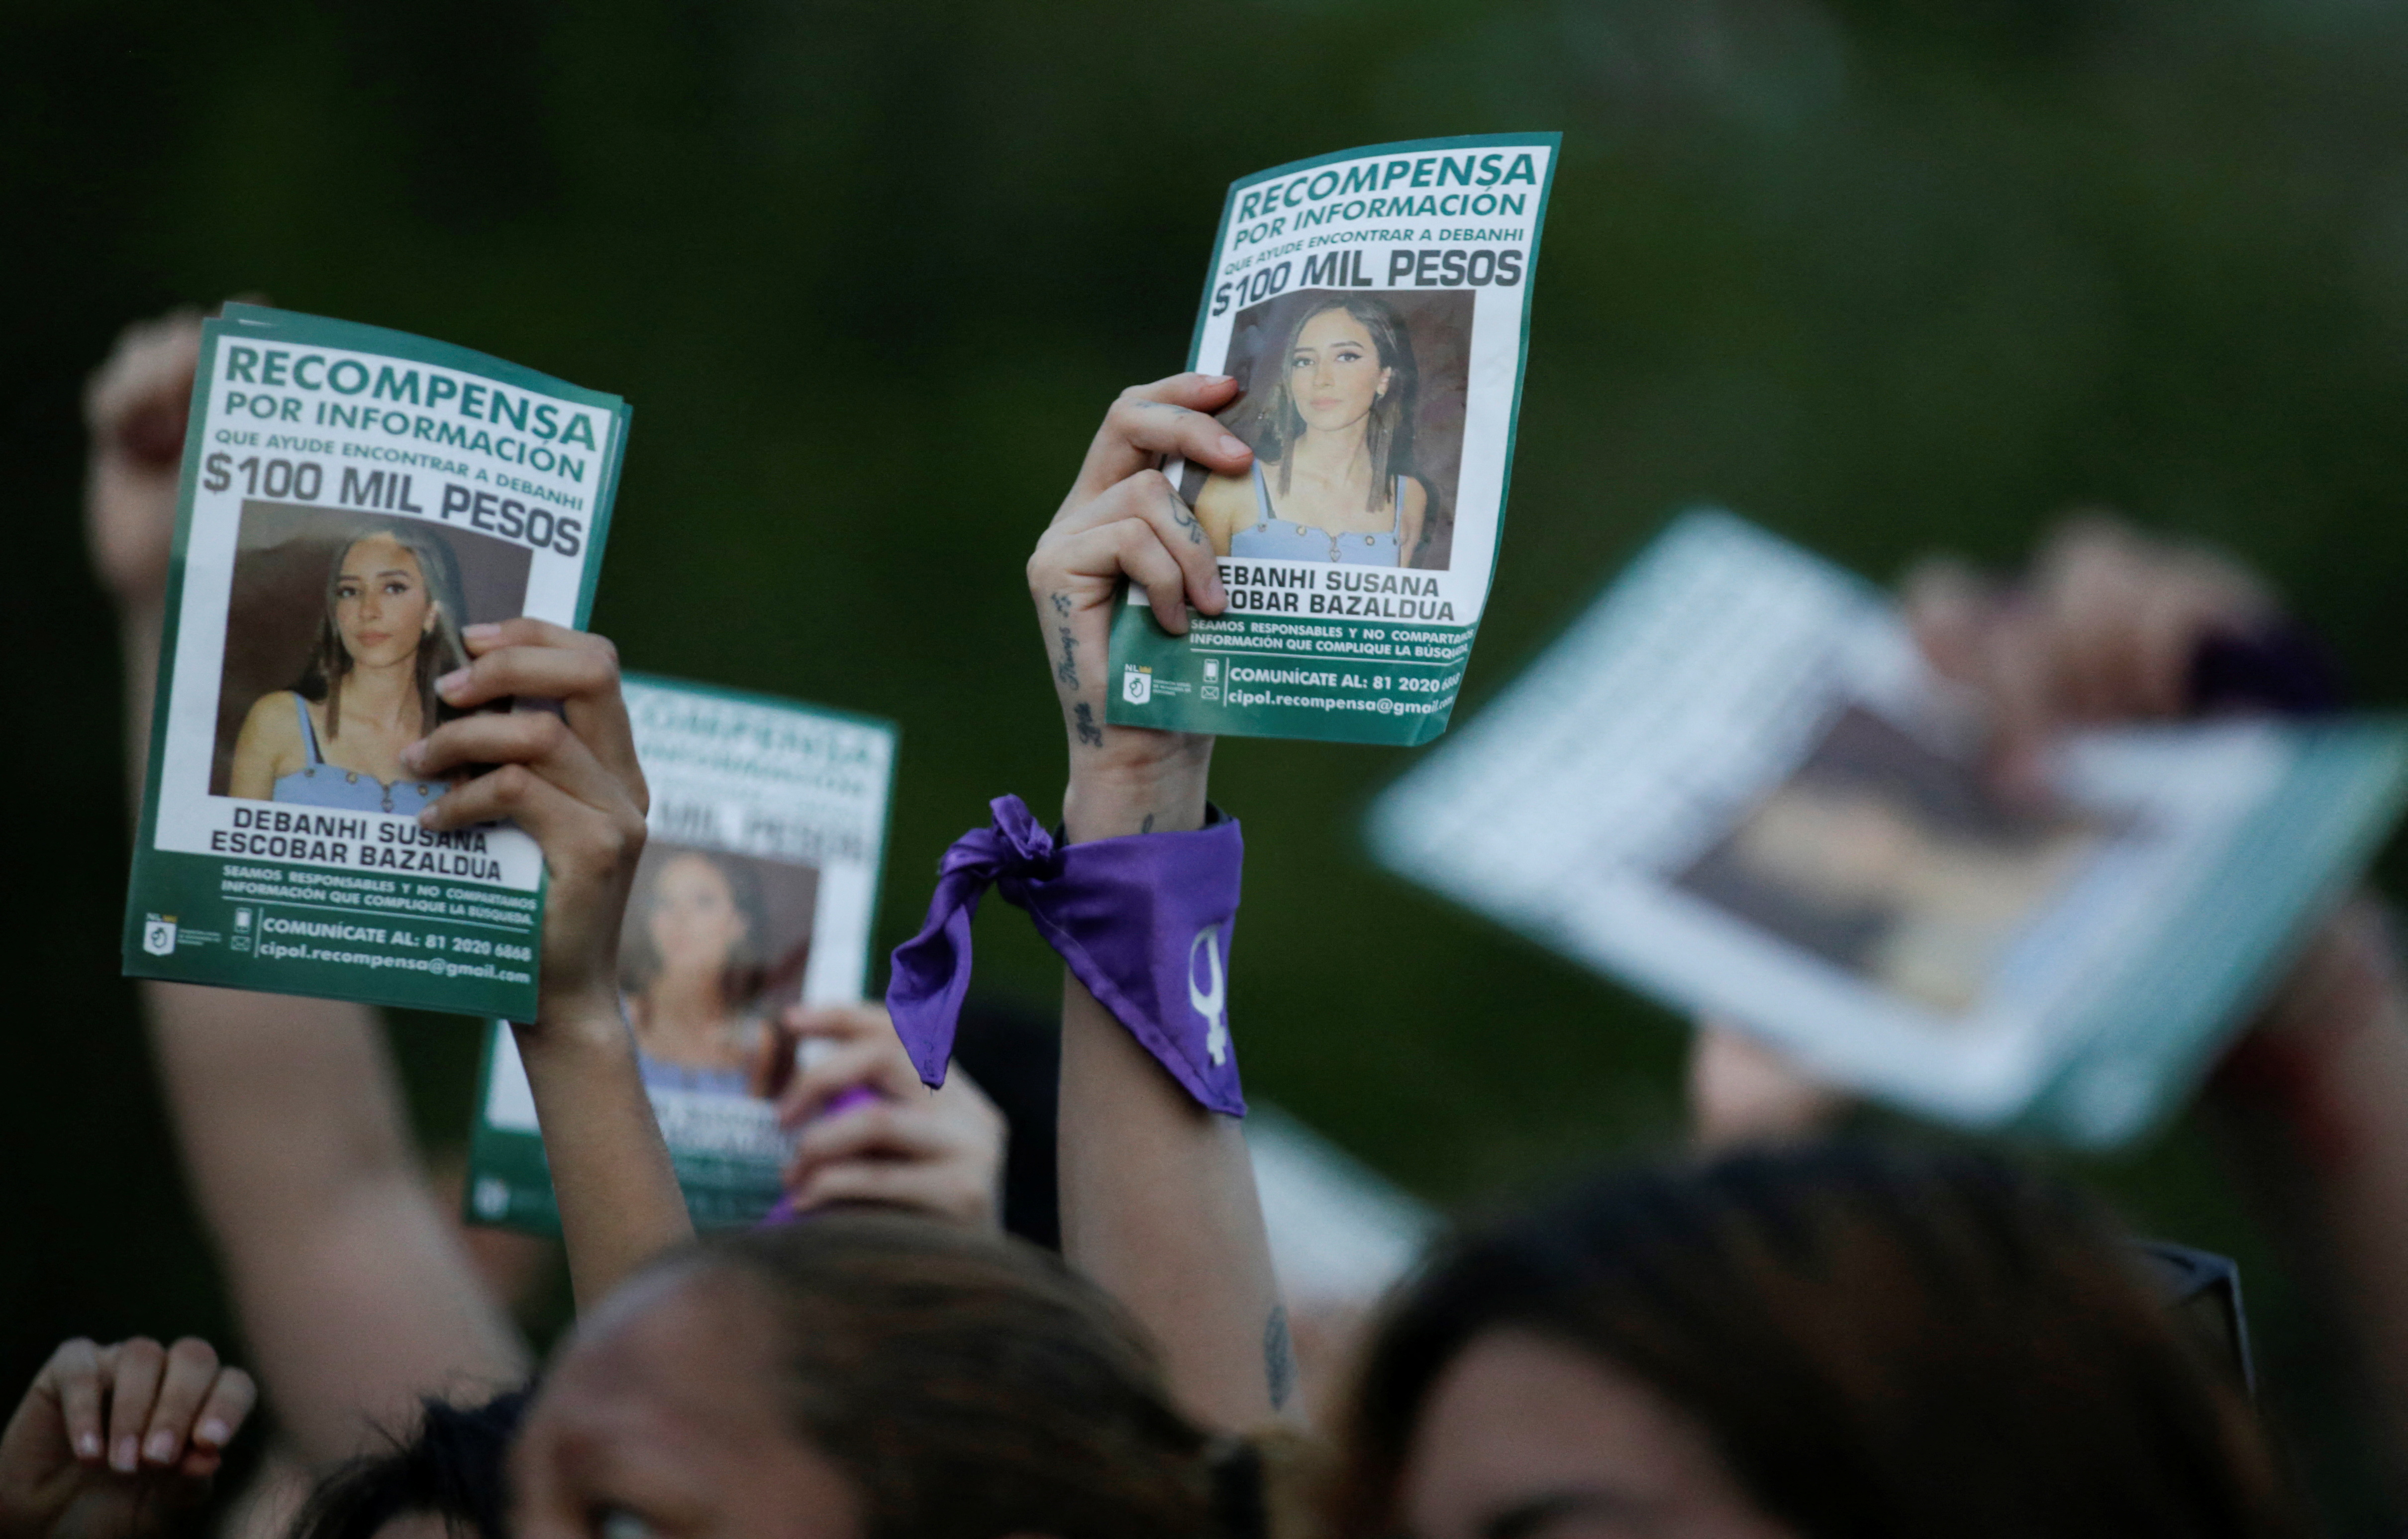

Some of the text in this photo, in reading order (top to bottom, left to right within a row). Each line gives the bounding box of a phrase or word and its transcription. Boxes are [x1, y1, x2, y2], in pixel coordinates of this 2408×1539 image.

[1237, 153, 1536, 223] RECOMPENSA
[1233, 187, 1526, 250] POR INFORMACIÓN
[1224, 228, 1523, 275] QUE AYUDE ENCONTRAR A DEBANHI
[1212, 249, 1522, 317] $100 MIL PESOS
[226, 345, 598, 451] RECOMPENSA
[225, 393, 585, 483] POR INFORMACIÓN
[216, 429, 584, 511] QUE AYUDE ENCONTRAR A DEBANHI
[204, 451, 582, 557] $100 MIL PESOS
[1218, 565, 1439, 597] EBANHI SUSANA
[1225, 589, 1454, 621] OBAR BAZALDUA
[1191, 619, 1244, 633] SEAMOS
[1251, 622, 1342, 639] RESPONSABLES
[1349, 628, 1357, 639] Y
[1363, 628, 1384, 641] NO
[1191, 633, 1282, 651] INFORMACIÓN
[1287, 638, 1311, 652] QUE
[1316, 640, 1392, 656] COMPLIQUE
[1395, 645, 1411, 656] LA
[1230, 666, 1337, 688] COMUNÍCATE
[1342, 674, 1368, 689] AL:
[1373, 676, 1391, 690] 81
[1399, 677, 1440, 693] 2020
[234, 808, 487, 854] DEBANHI SUSANA
[211, 830, 501, 881] ESCOBAR BAZALDUA
[221, 880, 326, 901] INFORMACIÓN
[331, 890, 360, 905] QUE
[364, 895, 446, 914] COMPLIQUE
[449, 904, 466, 915] LA
[223, 865, 537, 911] SEAMOS RESPONSABLES Y NO COMPARTAMOS
[259, 940, 530, 984] cipol.recompensa@gmail.com
[264, 916, 532, 962] COMUNÍCATE AL: 81 2020 6868
